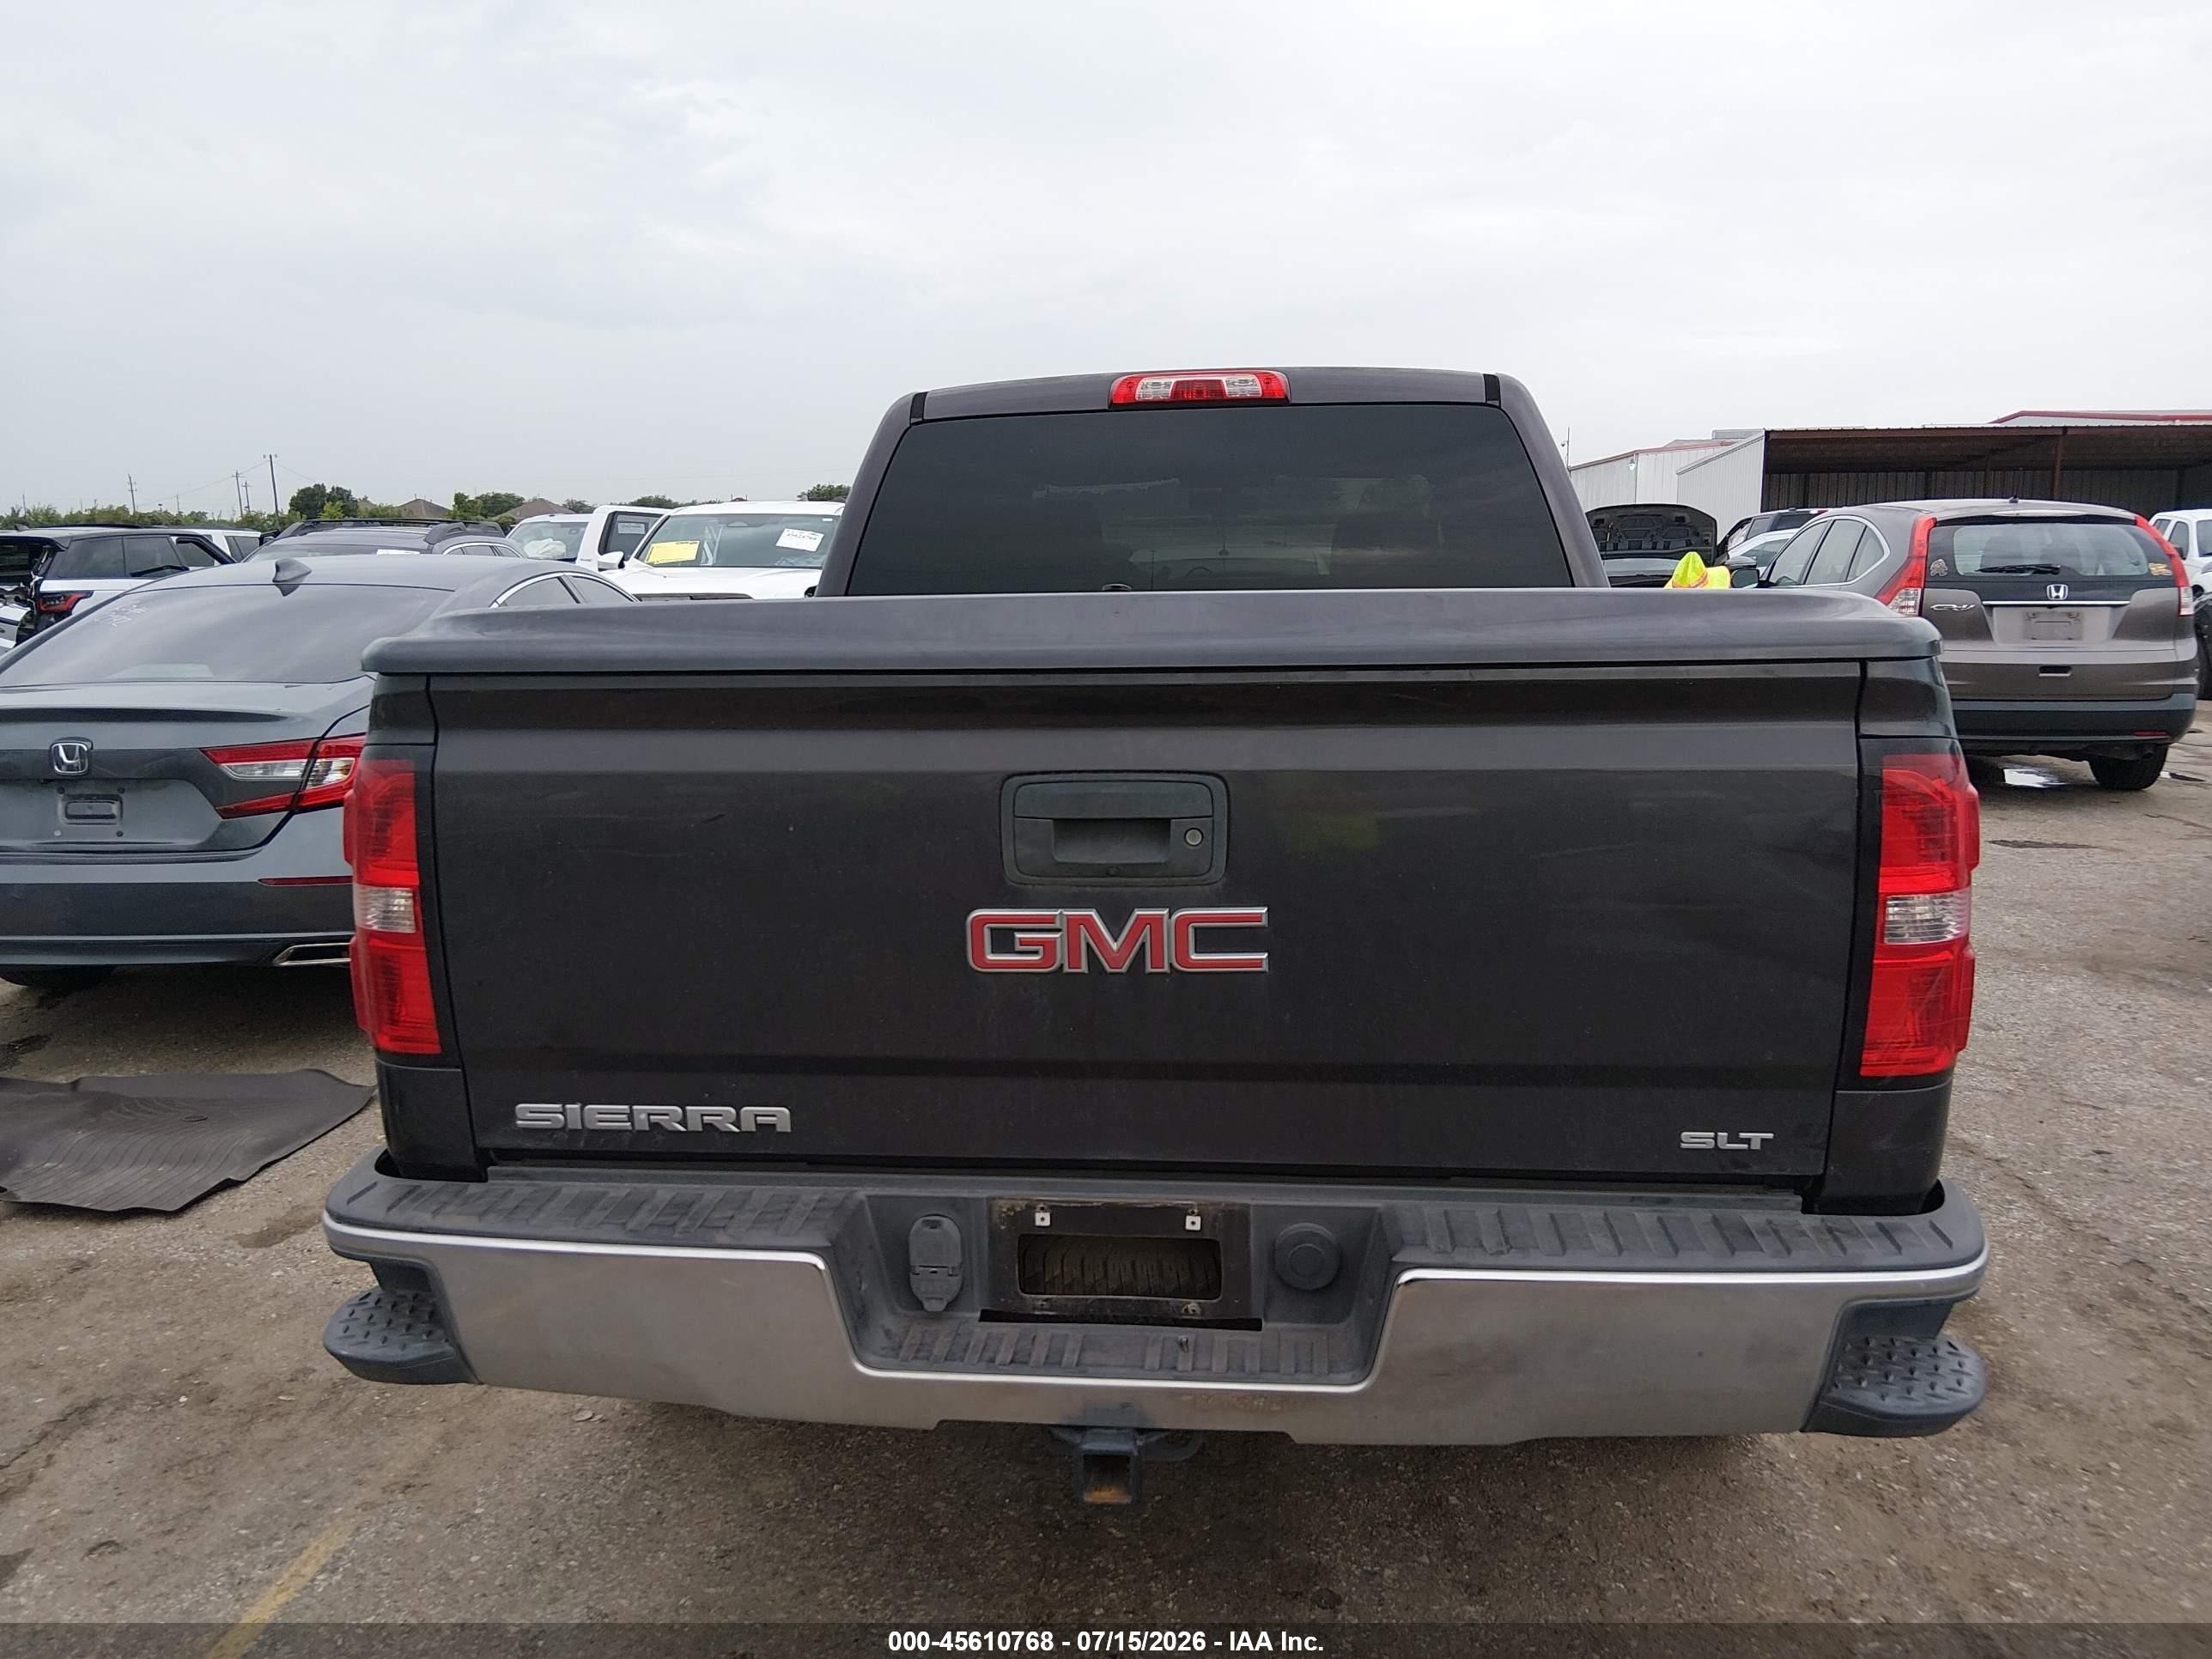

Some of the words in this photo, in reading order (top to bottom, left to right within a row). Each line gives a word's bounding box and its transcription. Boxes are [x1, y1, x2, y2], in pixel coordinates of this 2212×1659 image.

[967, 907, 1269, 973] GMC
[515, 1103, 792, 1133] SIERRA
[1680, 1132, 1774, 1150] SLT
